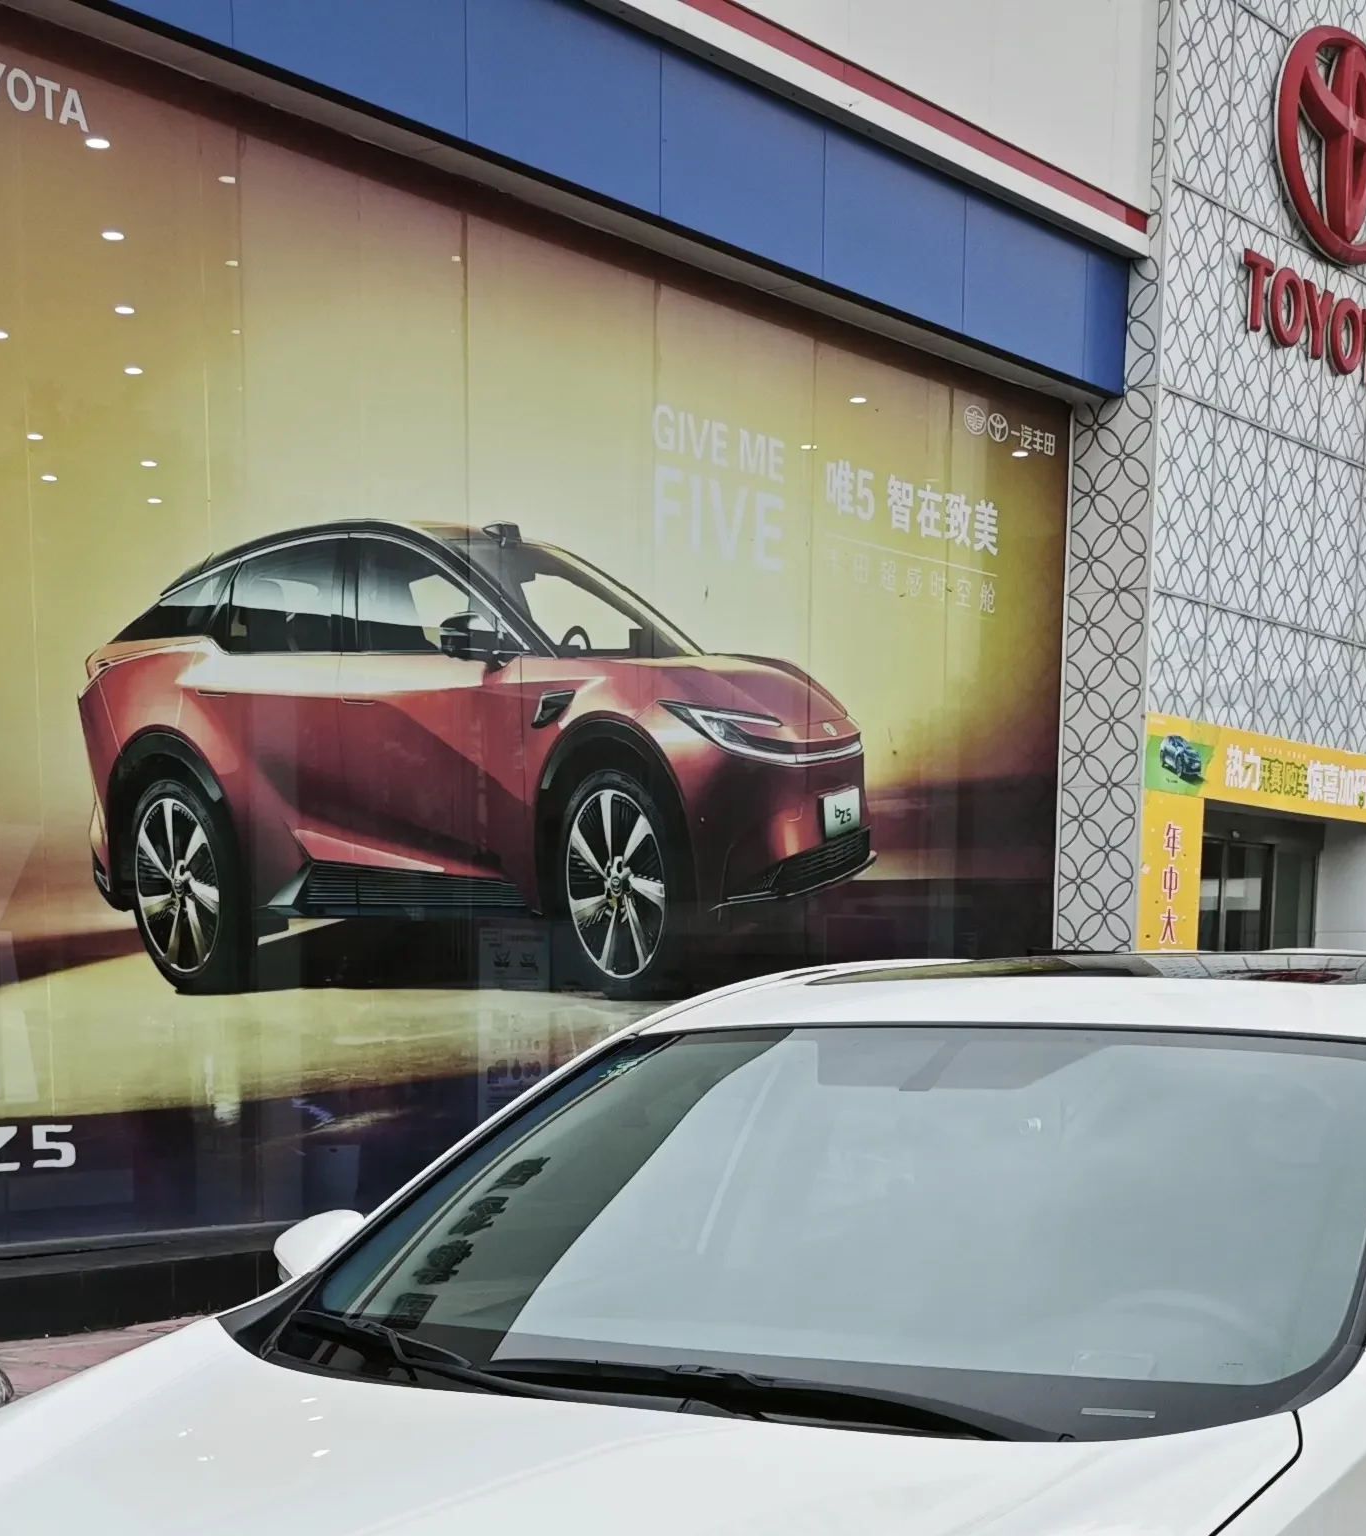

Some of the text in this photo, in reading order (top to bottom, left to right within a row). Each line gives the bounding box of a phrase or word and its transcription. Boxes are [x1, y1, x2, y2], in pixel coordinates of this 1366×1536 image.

[652, 403, 785, 483] GIVE ME
[1010, 423, 1056, 457] 一汽丰田
[653, 464, 785, 573] FIVE
[825, 458, 999, 556] 唯5 智在致美
